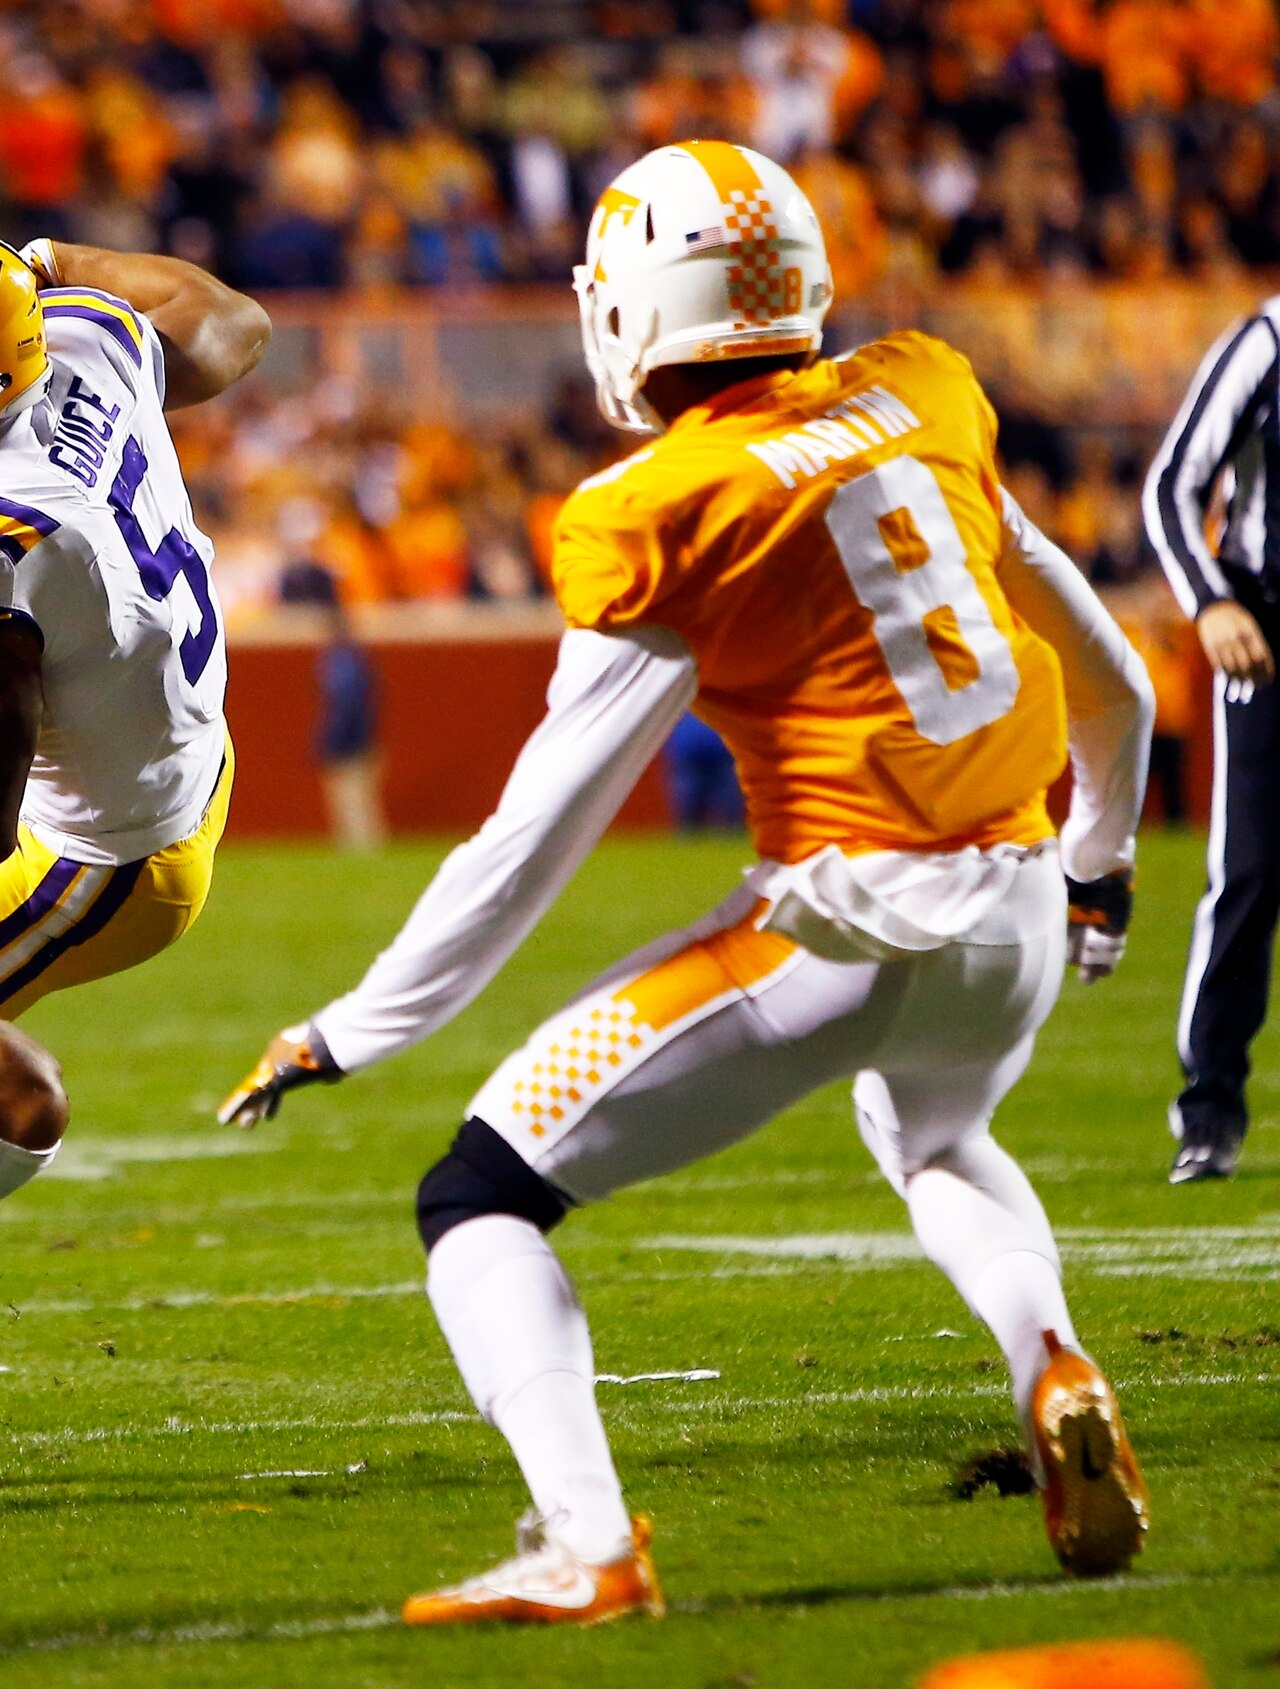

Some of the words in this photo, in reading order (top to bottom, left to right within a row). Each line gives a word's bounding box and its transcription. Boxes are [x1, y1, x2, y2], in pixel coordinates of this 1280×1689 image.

[783, 266, 802, 315] 8
[48, 375, 121, 488] GUICE
[745, 384, 922, 490] MARTIN
[108, 433, 218, 687] 5
[825, 454, 1020, 746] 8
